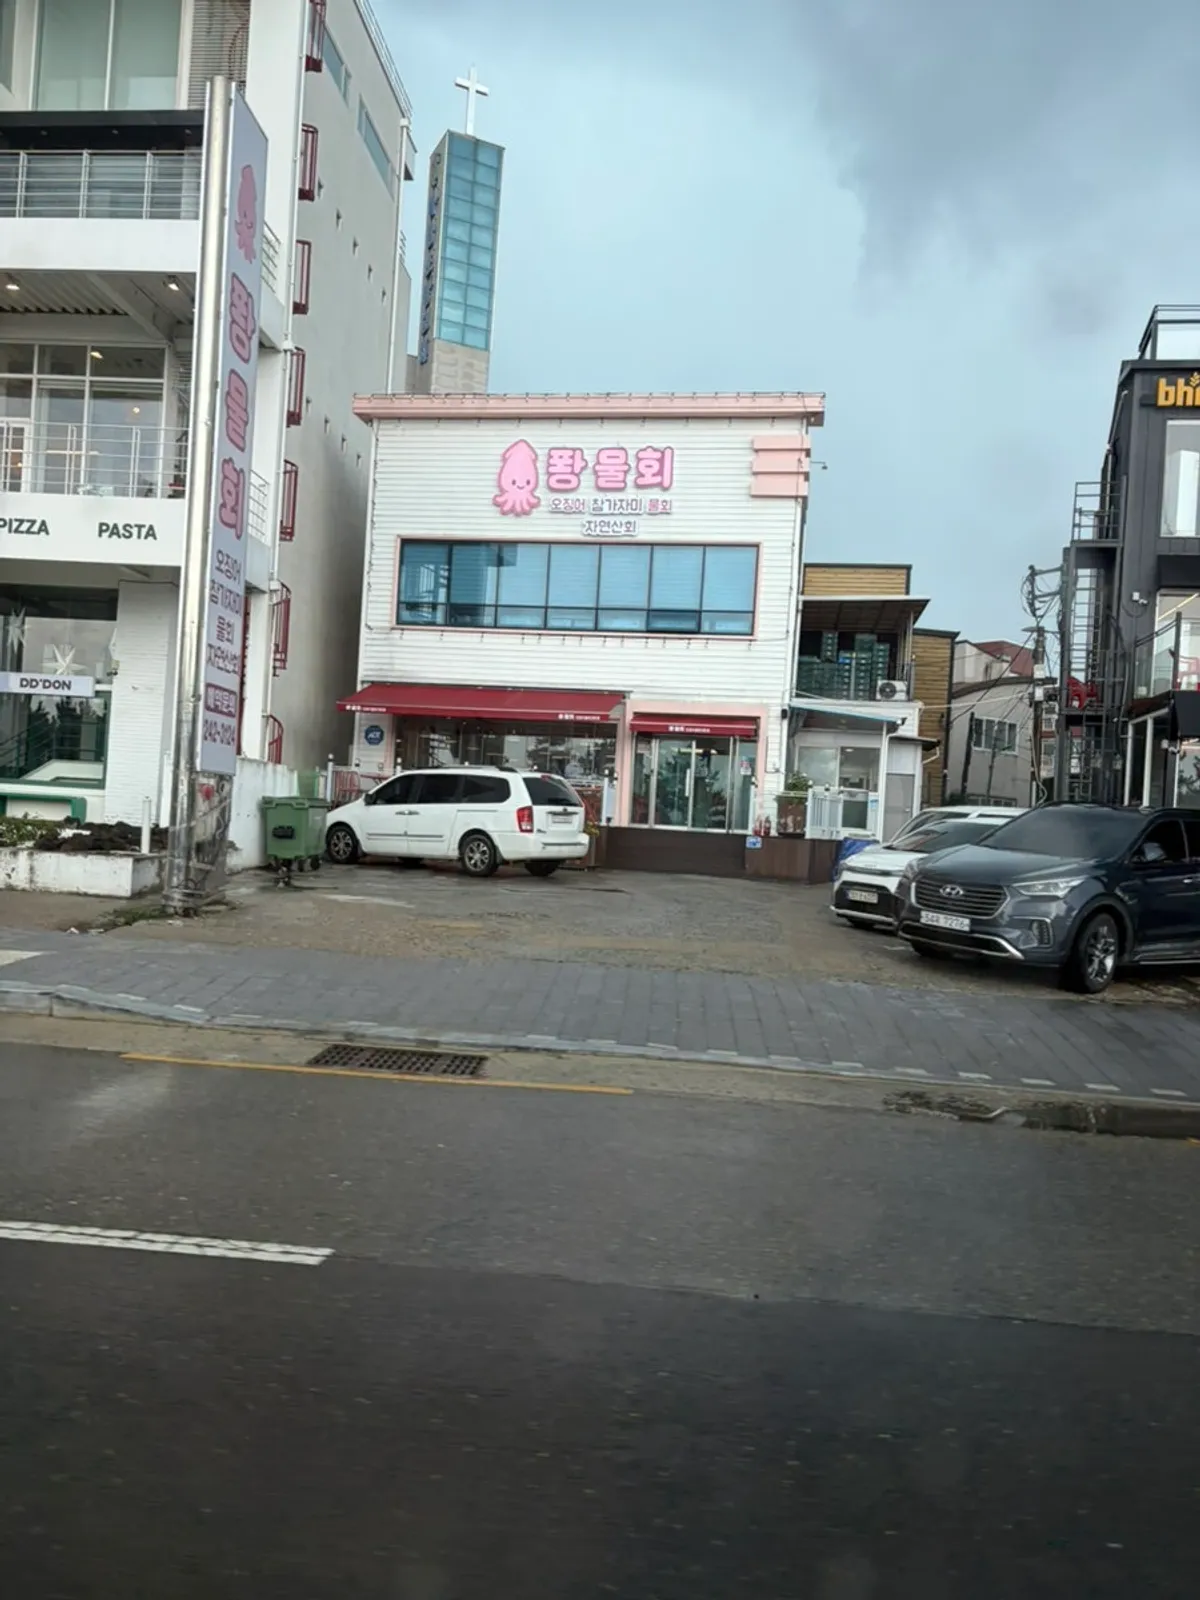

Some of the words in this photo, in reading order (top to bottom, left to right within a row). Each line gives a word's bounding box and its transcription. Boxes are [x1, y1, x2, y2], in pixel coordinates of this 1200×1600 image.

[551, 498, 586, 511] 오징어
[592, 498, 643, 513] 참가자미
[648, 498, 672, 512] 물회
[0, 516, 50, 536] PIZZA
[98, 522, 157, 541] PASTA
[584, 520, 637, 533] 자연산회
[215, 549, 241, 585] 오징어
[215, 614, 235, 645] 물회
